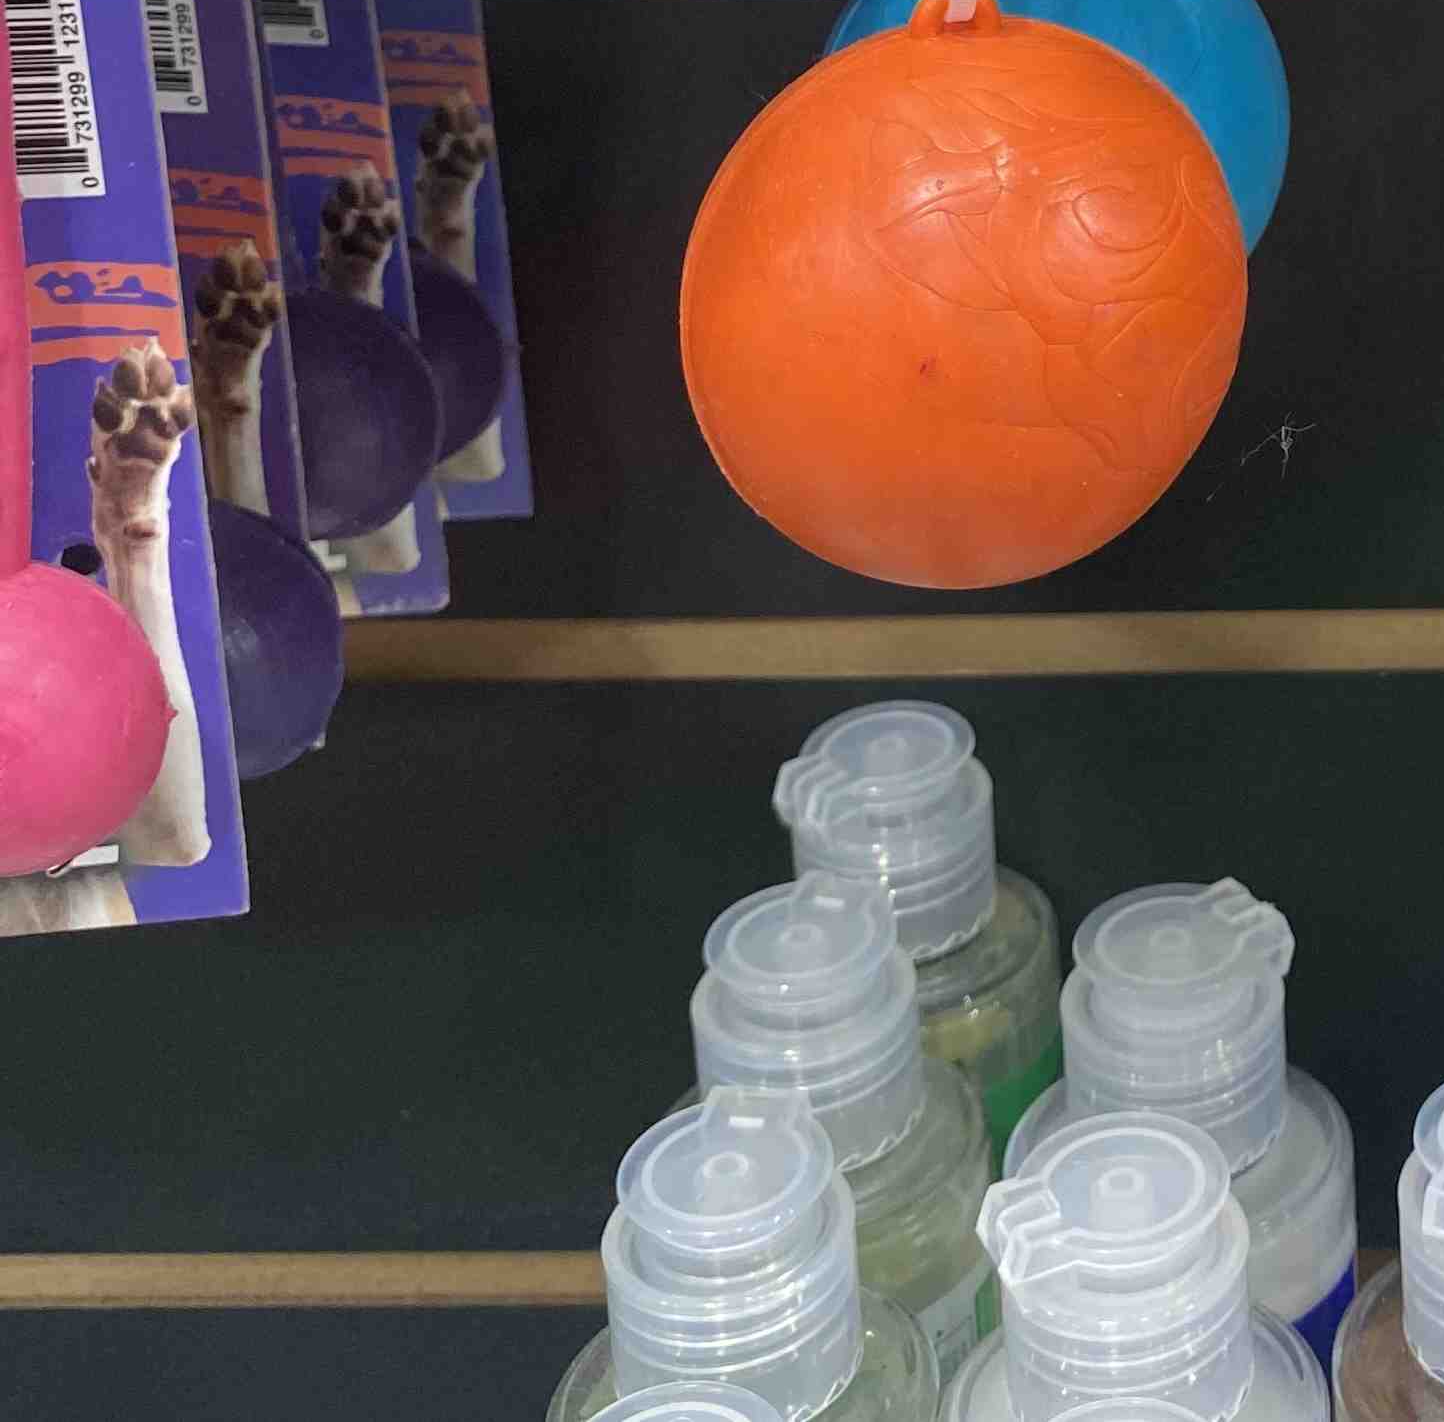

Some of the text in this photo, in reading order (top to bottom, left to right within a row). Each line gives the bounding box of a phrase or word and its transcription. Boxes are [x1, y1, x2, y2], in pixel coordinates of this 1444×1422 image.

[176, 3, 197, 66] 731299
[68, 72, 94, 144] 731299
[82, 177, 100, 188] 0
